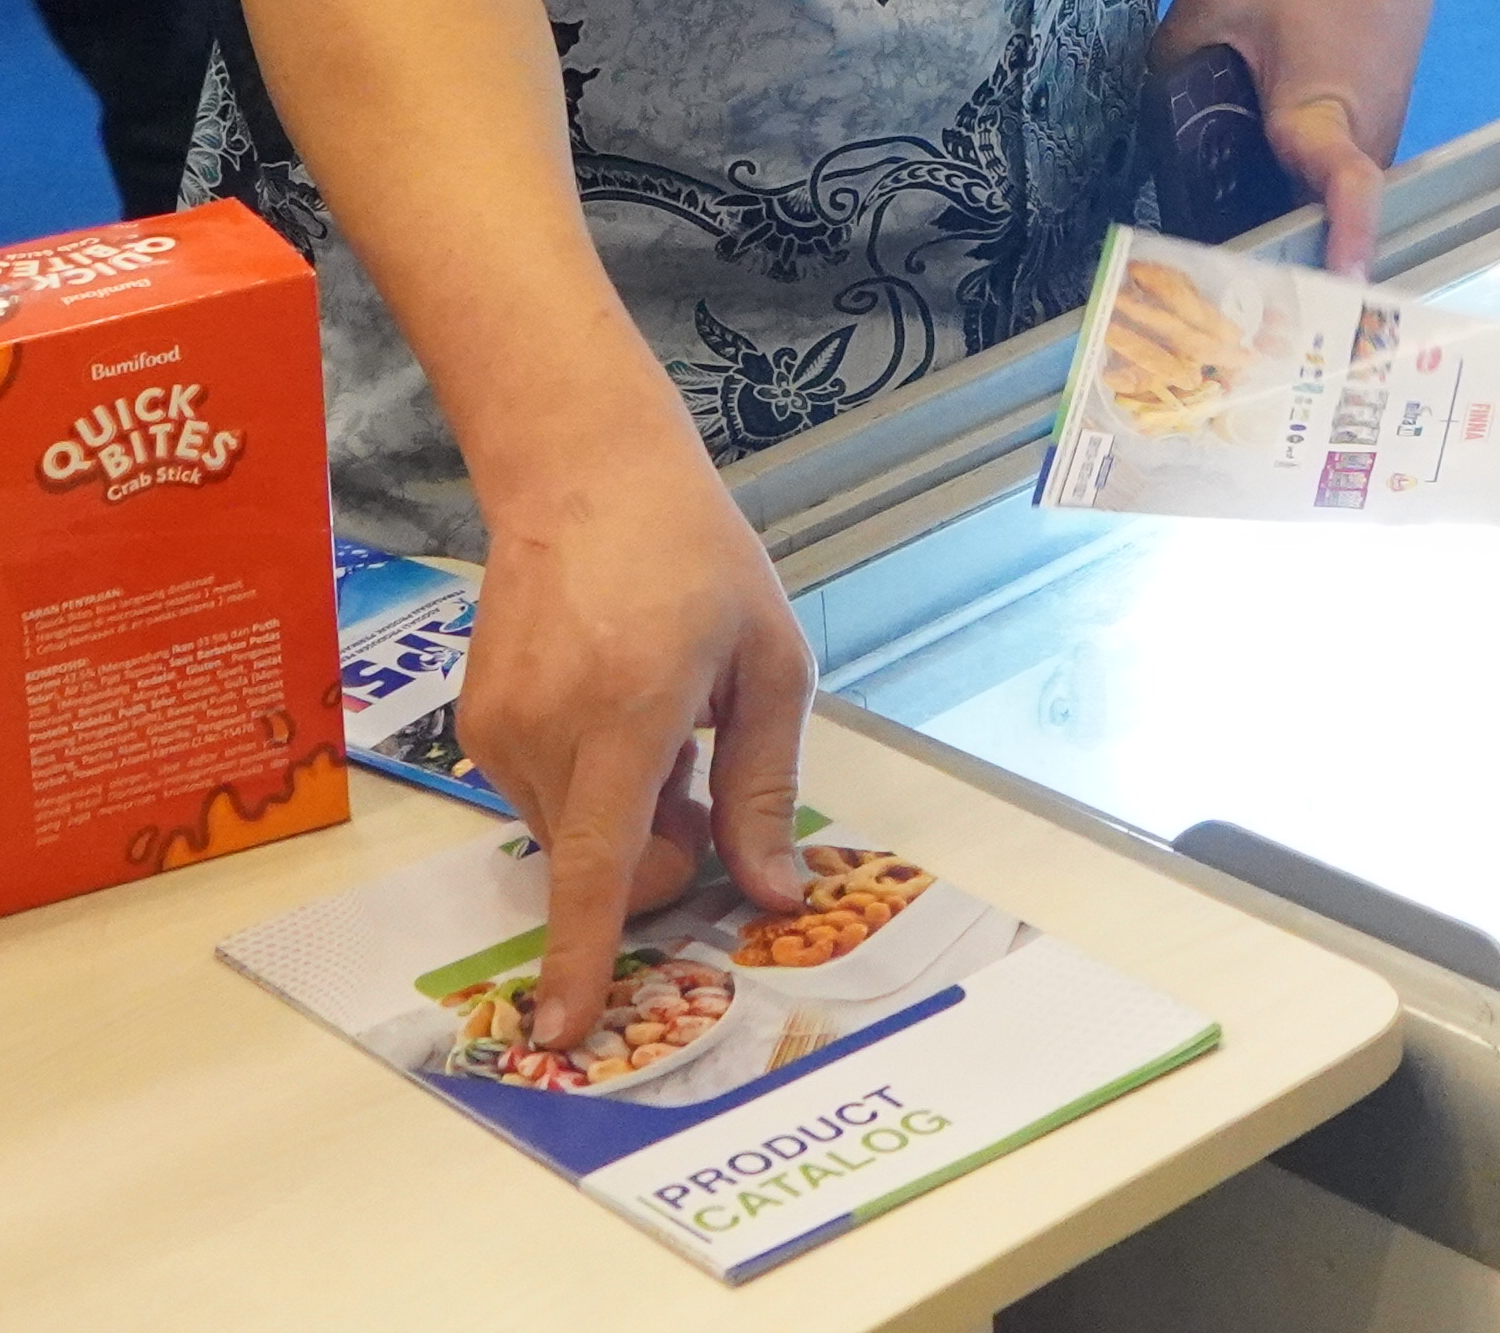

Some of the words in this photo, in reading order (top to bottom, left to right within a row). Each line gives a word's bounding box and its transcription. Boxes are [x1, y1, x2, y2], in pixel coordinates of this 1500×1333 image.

[90, 345, 183, 384] Bumifood
[41, 383, 204, 483] QUICK
[1465, 402, 1492, 441] FINNA
[101, 429, 240, 480] BITES
[106, 471, 152, 502] Crab
[156, 466, 203, 489] Stick
[654, 1083, 907, 1212] PRODUCT
[693, 1102, 954, 1236] CATALOG
